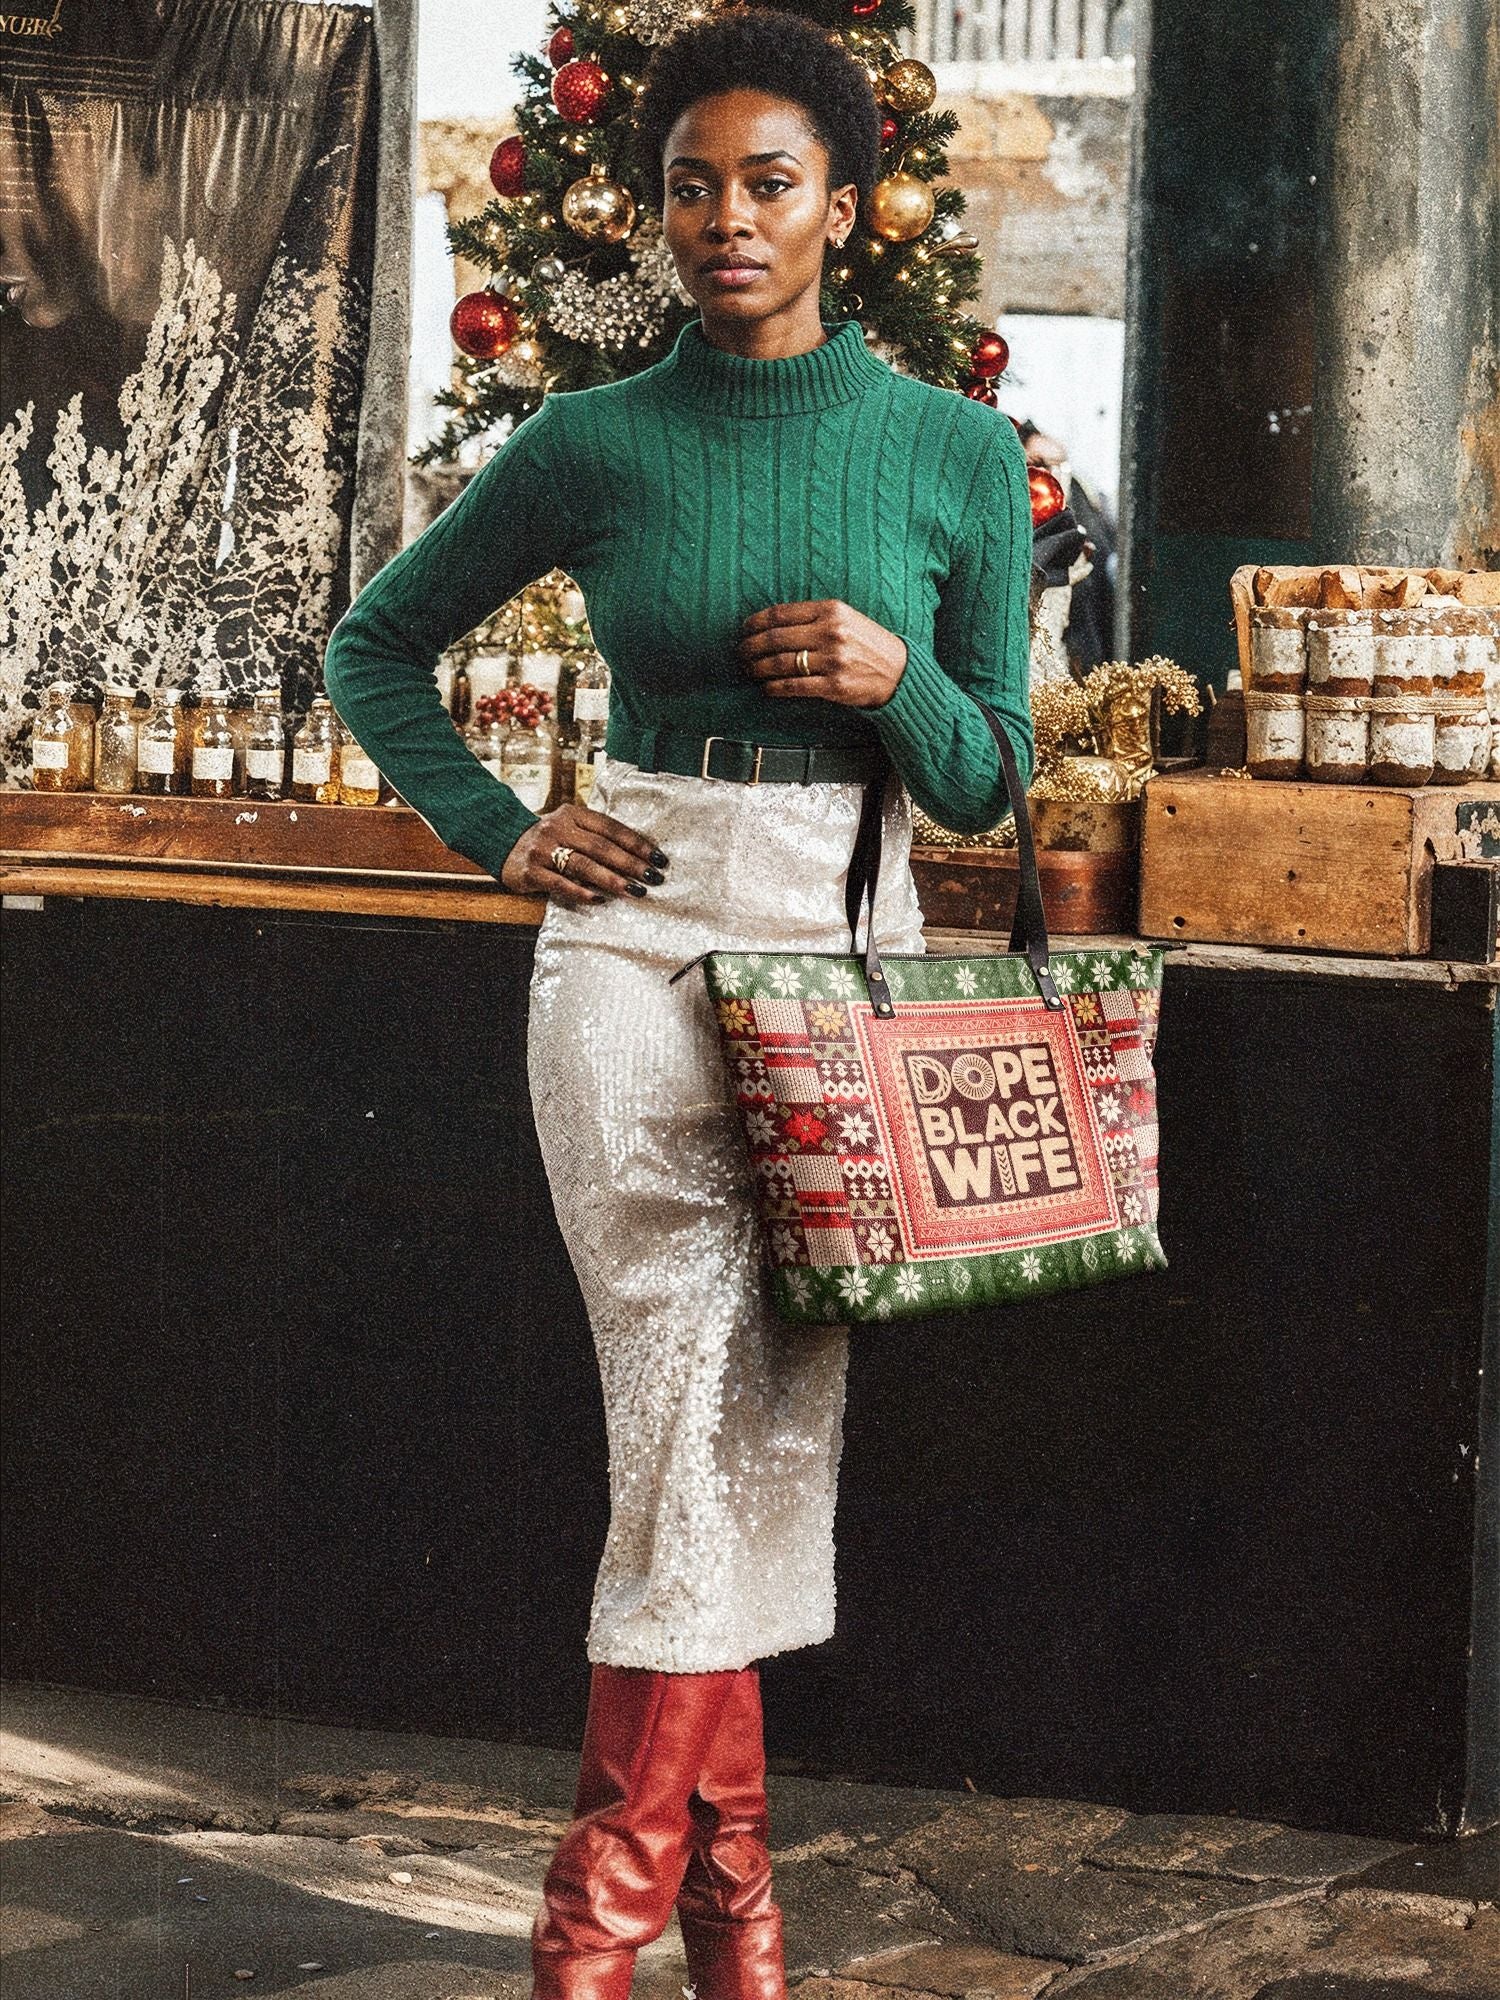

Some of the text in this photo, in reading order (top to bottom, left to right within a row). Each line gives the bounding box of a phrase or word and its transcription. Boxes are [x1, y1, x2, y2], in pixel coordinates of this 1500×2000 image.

[907, 1047, 1056, 1104] DOPE
[919, 1097, 1066, 1146] BLACK
[929, 1136, 1078, 1200] WIFE
